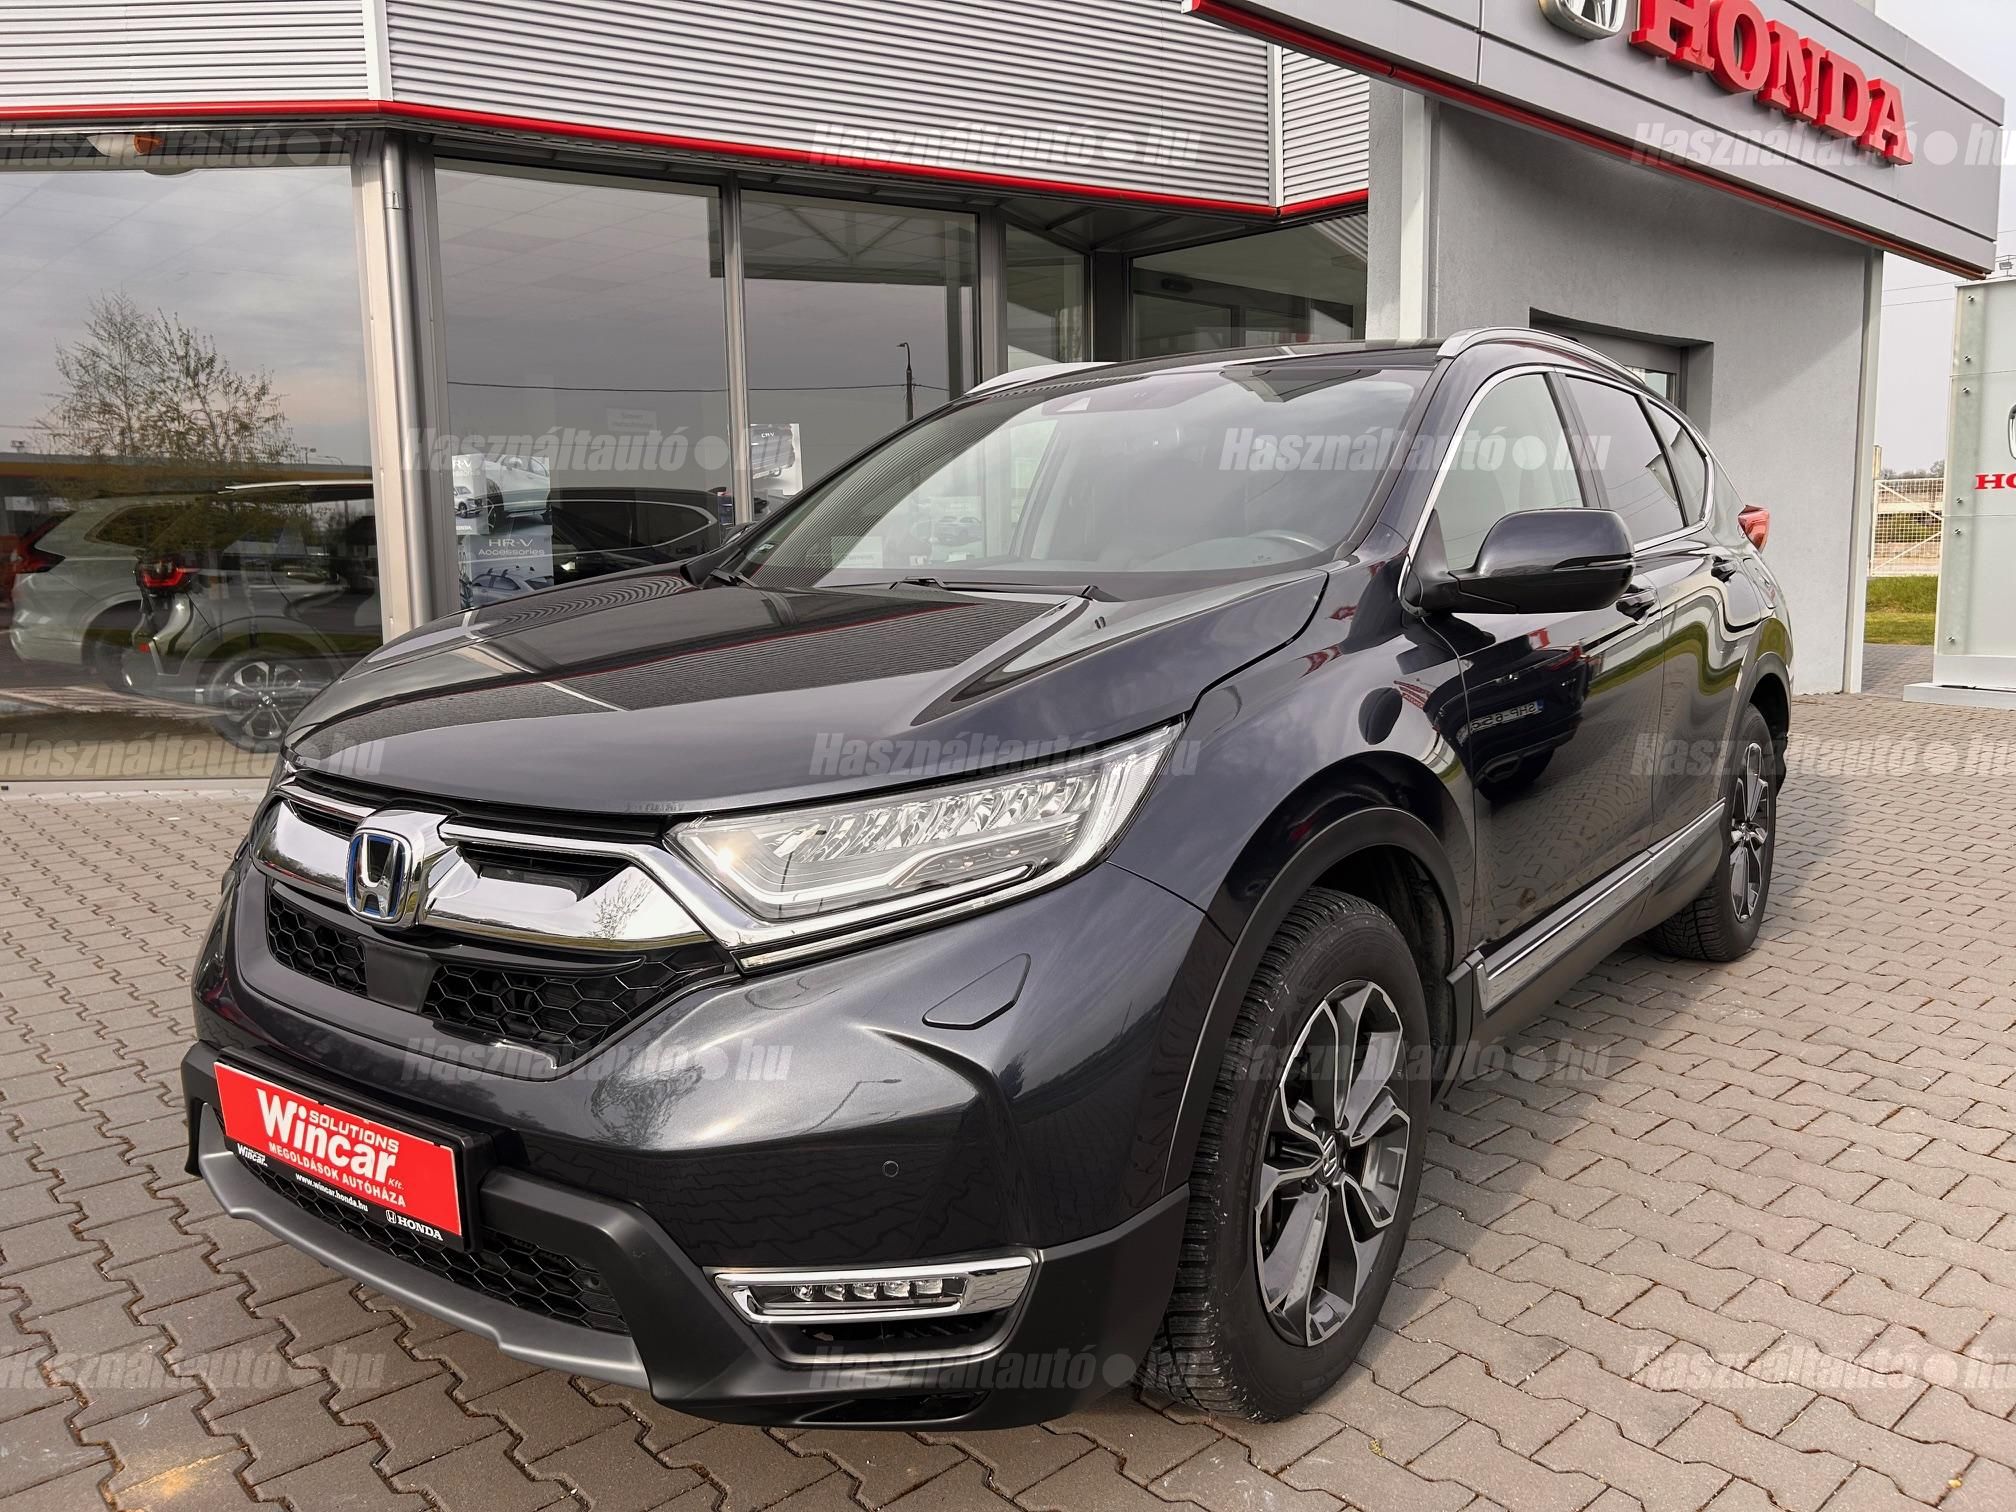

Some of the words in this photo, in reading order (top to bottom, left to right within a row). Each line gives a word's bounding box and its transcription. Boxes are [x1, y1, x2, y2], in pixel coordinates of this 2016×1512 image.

[1628, 0, 1914, 166] HONDA
[478, 547, 545, 556] Accessories
[488, 538, 534, 547] HR-V
[256, 1088, 397, 1184] Wincar
[388, 1177, 405, 1191] Kft.
[309, 1110, 399, 1153] SOLUTIONS
[237, 1142, 266, 1165] Wincar
[268, 1141, 340, 1181] MEGOLDÁSOK
[342, 1173, 407, 1208] AUTÓHÁZA
[295, 1173, 369, 1212] www.wincar.honda.hu
[397, 1216, 444, 1241] HONDA
